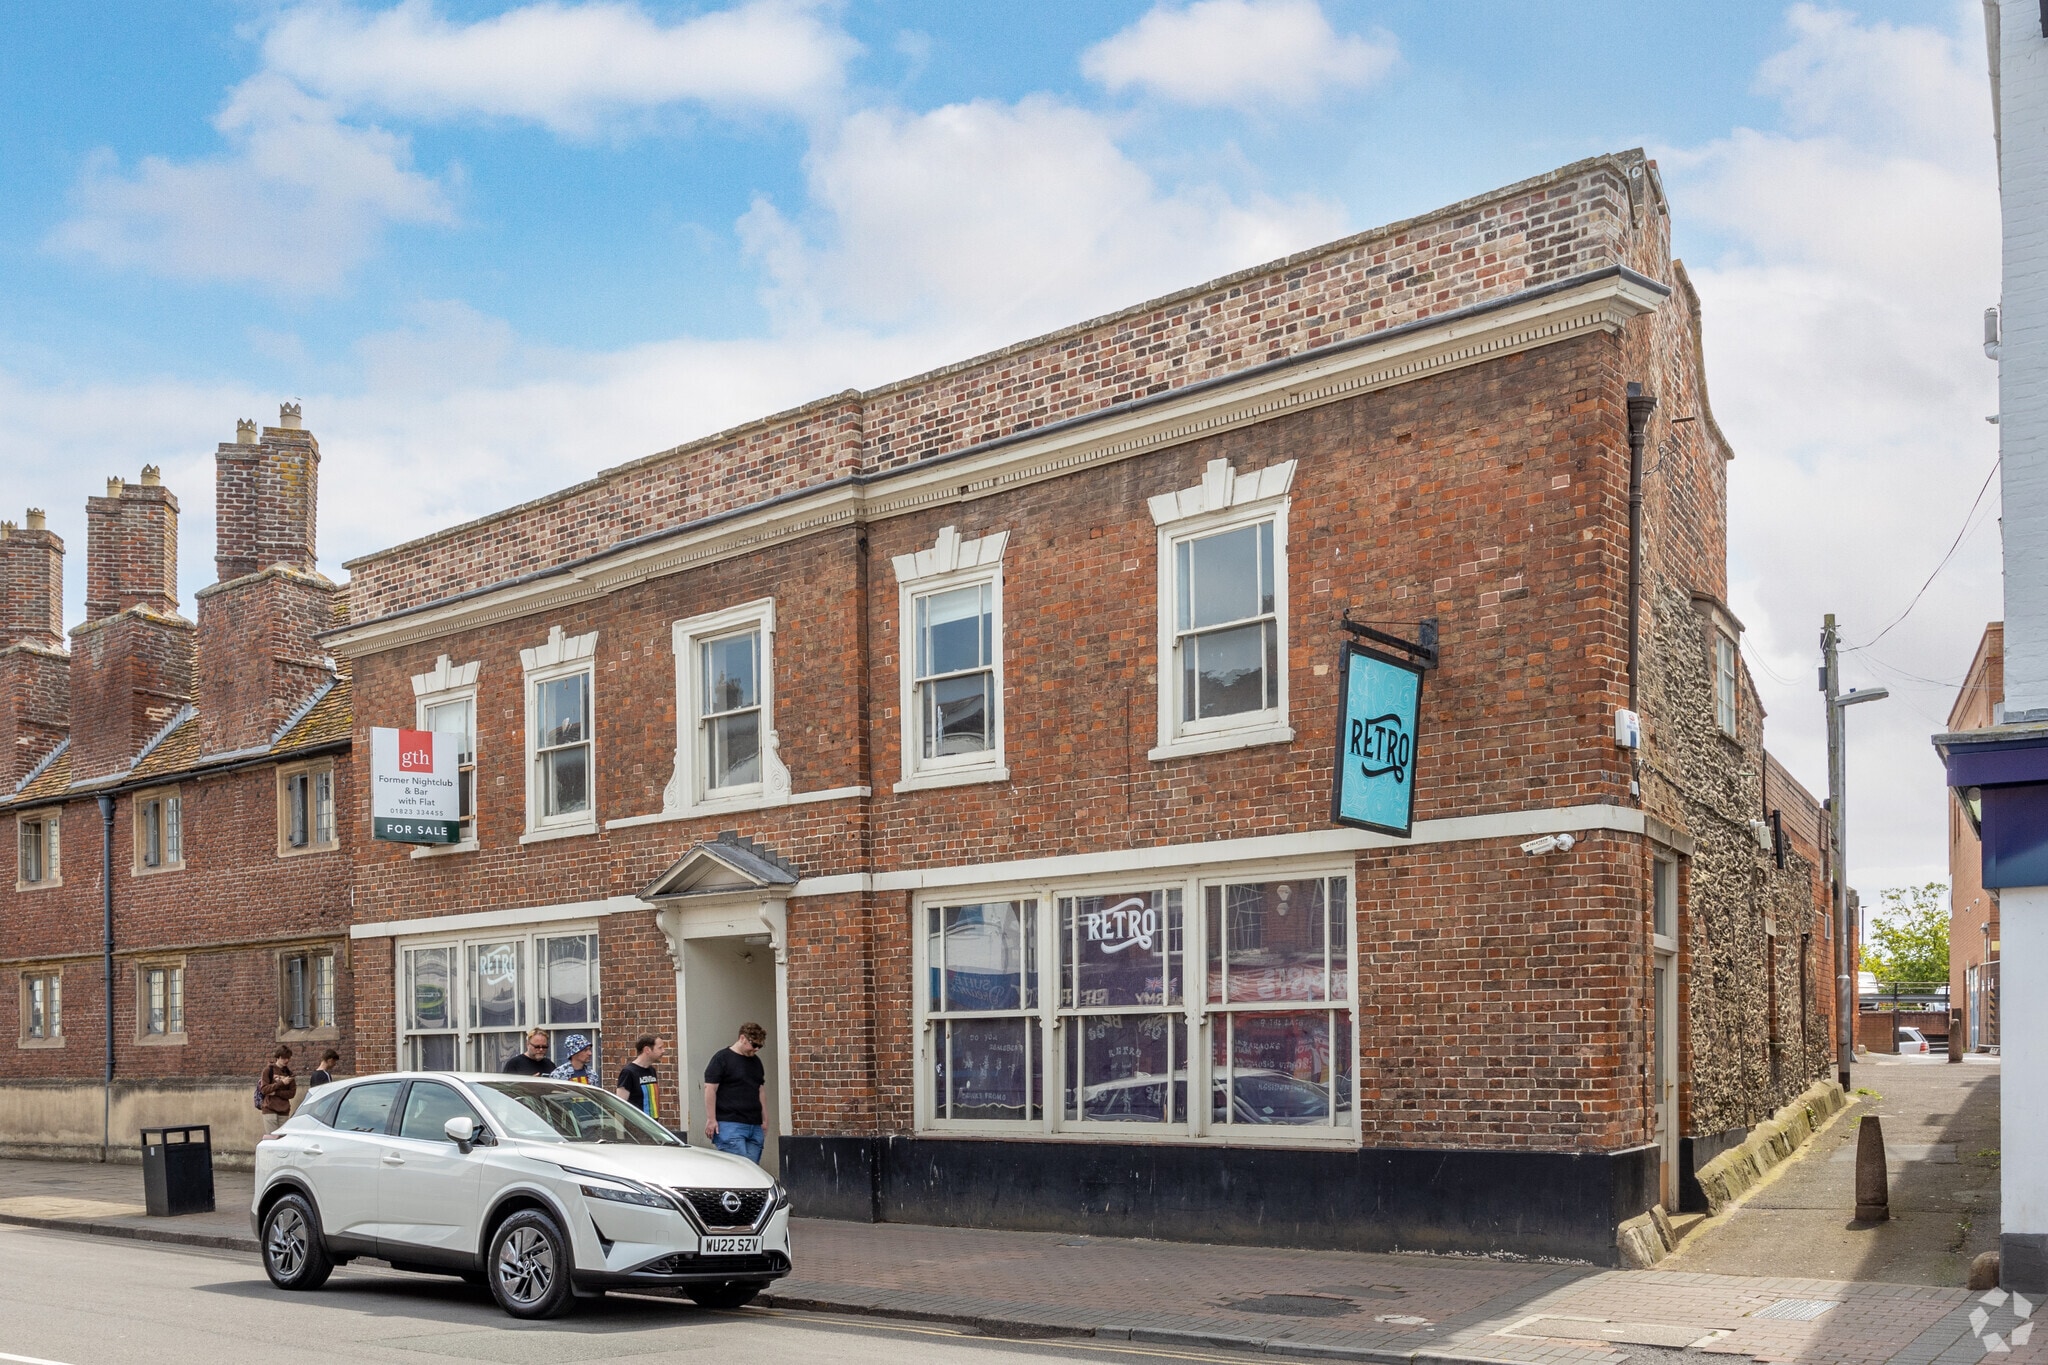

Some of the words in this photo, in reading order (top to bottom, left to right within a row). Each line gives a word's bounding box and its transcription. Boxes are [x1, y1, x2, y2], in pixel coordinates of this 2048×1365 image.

[1349, 713, 1410, 784] RETRO
[402, 749, 430, 768] gth
[378, 775, 410, 785] Former
[411, 777, 453, 788] Nightclub
[404, 787, 411, 795] &
[414, 788, 429, 796] Bar
[398, 797, 417, 806] with
[419, 798, 436, 807] Flat
[416, 809, 444, 817] 334455
[386, 824, 412, 834] FOR
[417, 825, 448, 836] SALE
[1087, 897, 1156, 955] RETRO
[706, 1239, 735, 1253] WU22
[737, 1238, 759, 1252] SZV
